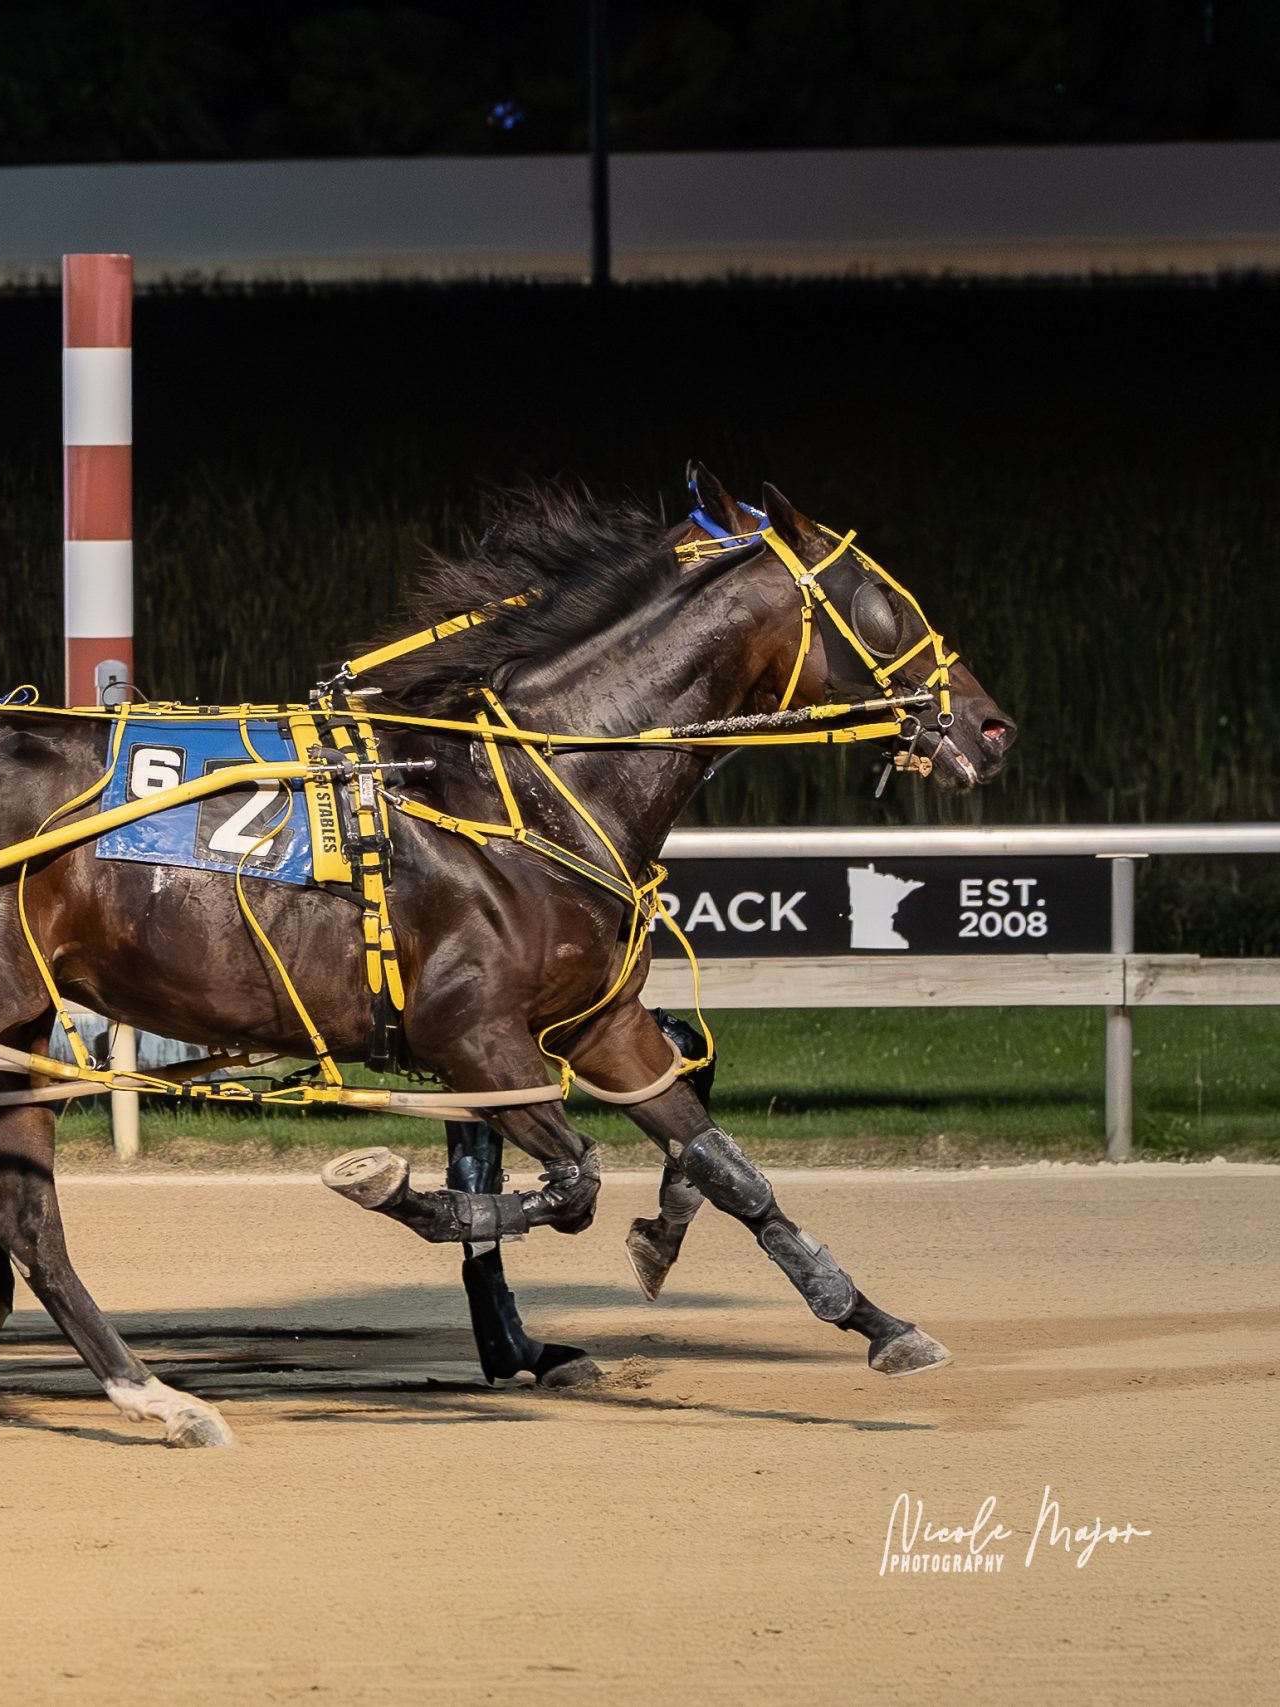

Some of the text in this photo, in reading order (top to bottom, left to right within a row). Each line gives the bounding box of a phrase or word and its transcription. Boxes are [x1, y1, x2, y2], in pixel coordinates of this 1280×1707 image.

[131, 748, 181, 800] 6
[316, 792, 338, 854] STABLES
[960, 878, 1046, 907] EST.
[958, 911, 1048, 938] 2008
